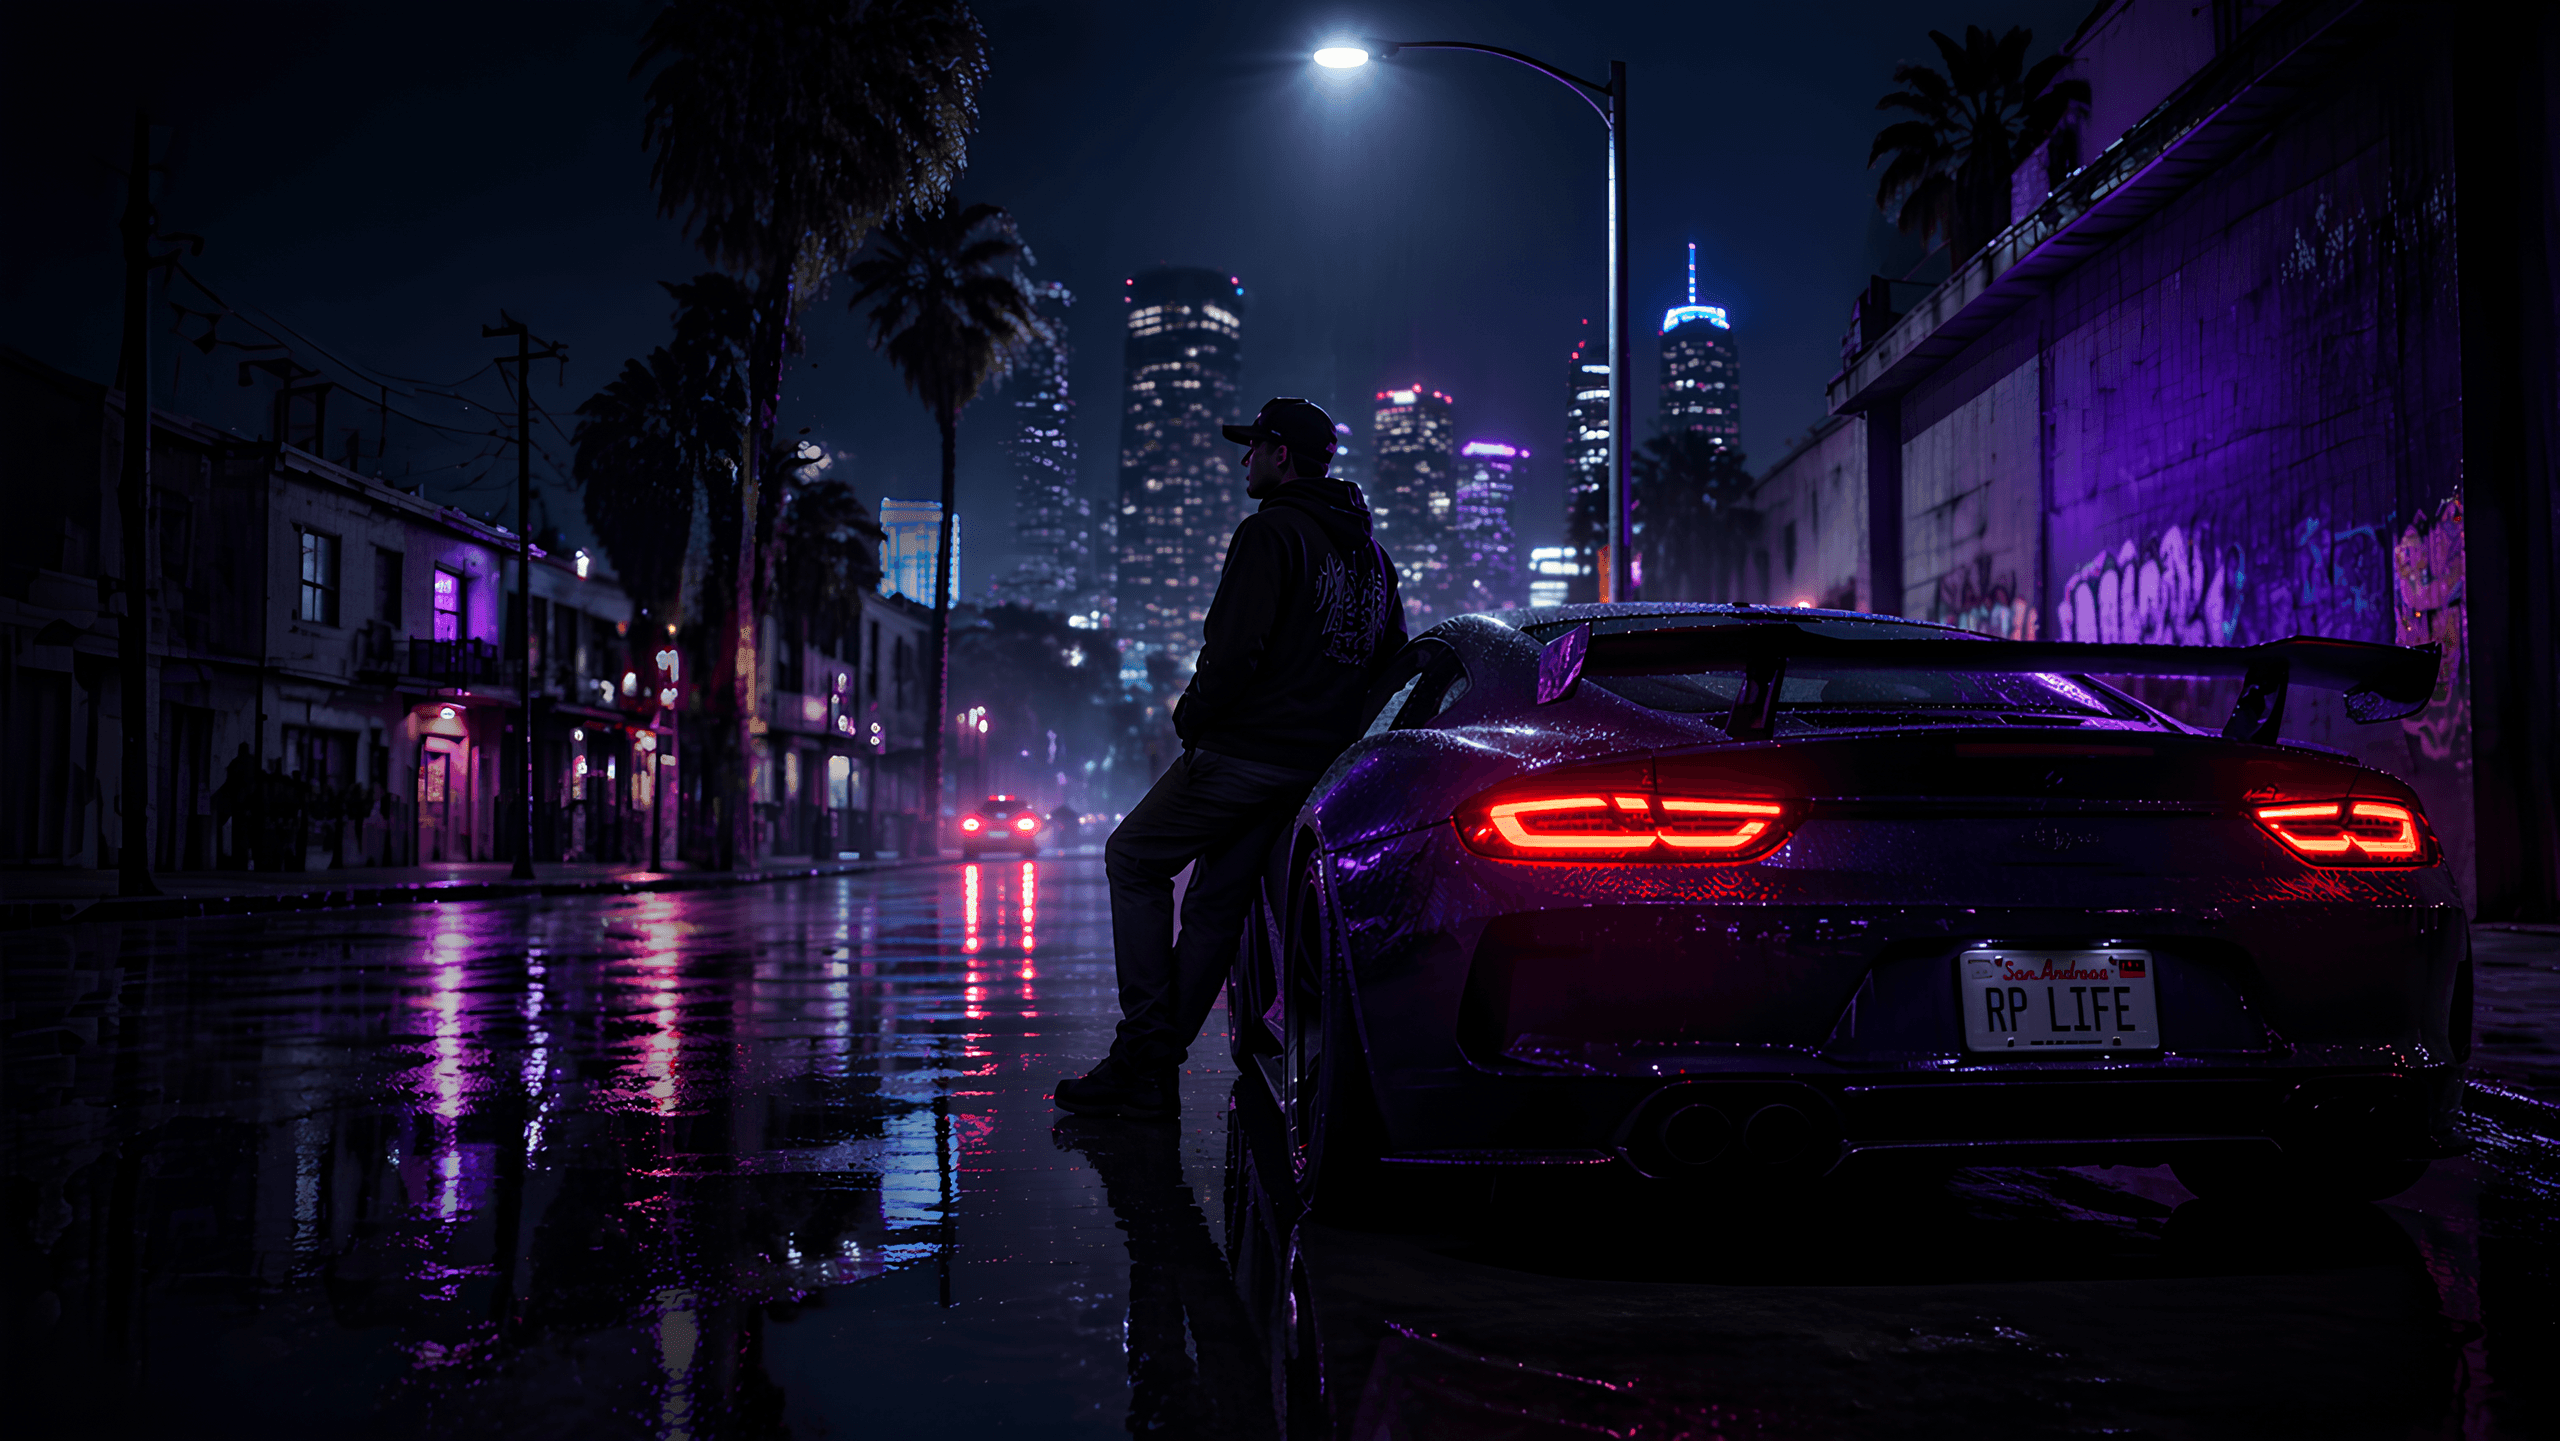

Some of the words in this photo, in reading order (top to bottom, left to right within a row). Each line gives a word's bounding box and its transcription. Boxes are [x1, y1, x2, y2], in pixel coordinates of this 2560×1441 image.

[2003, 960, 2036, 981] San
[1985, 987, 2028, 1032] RP
[2047, 986, 2136, 1032] LIFE
